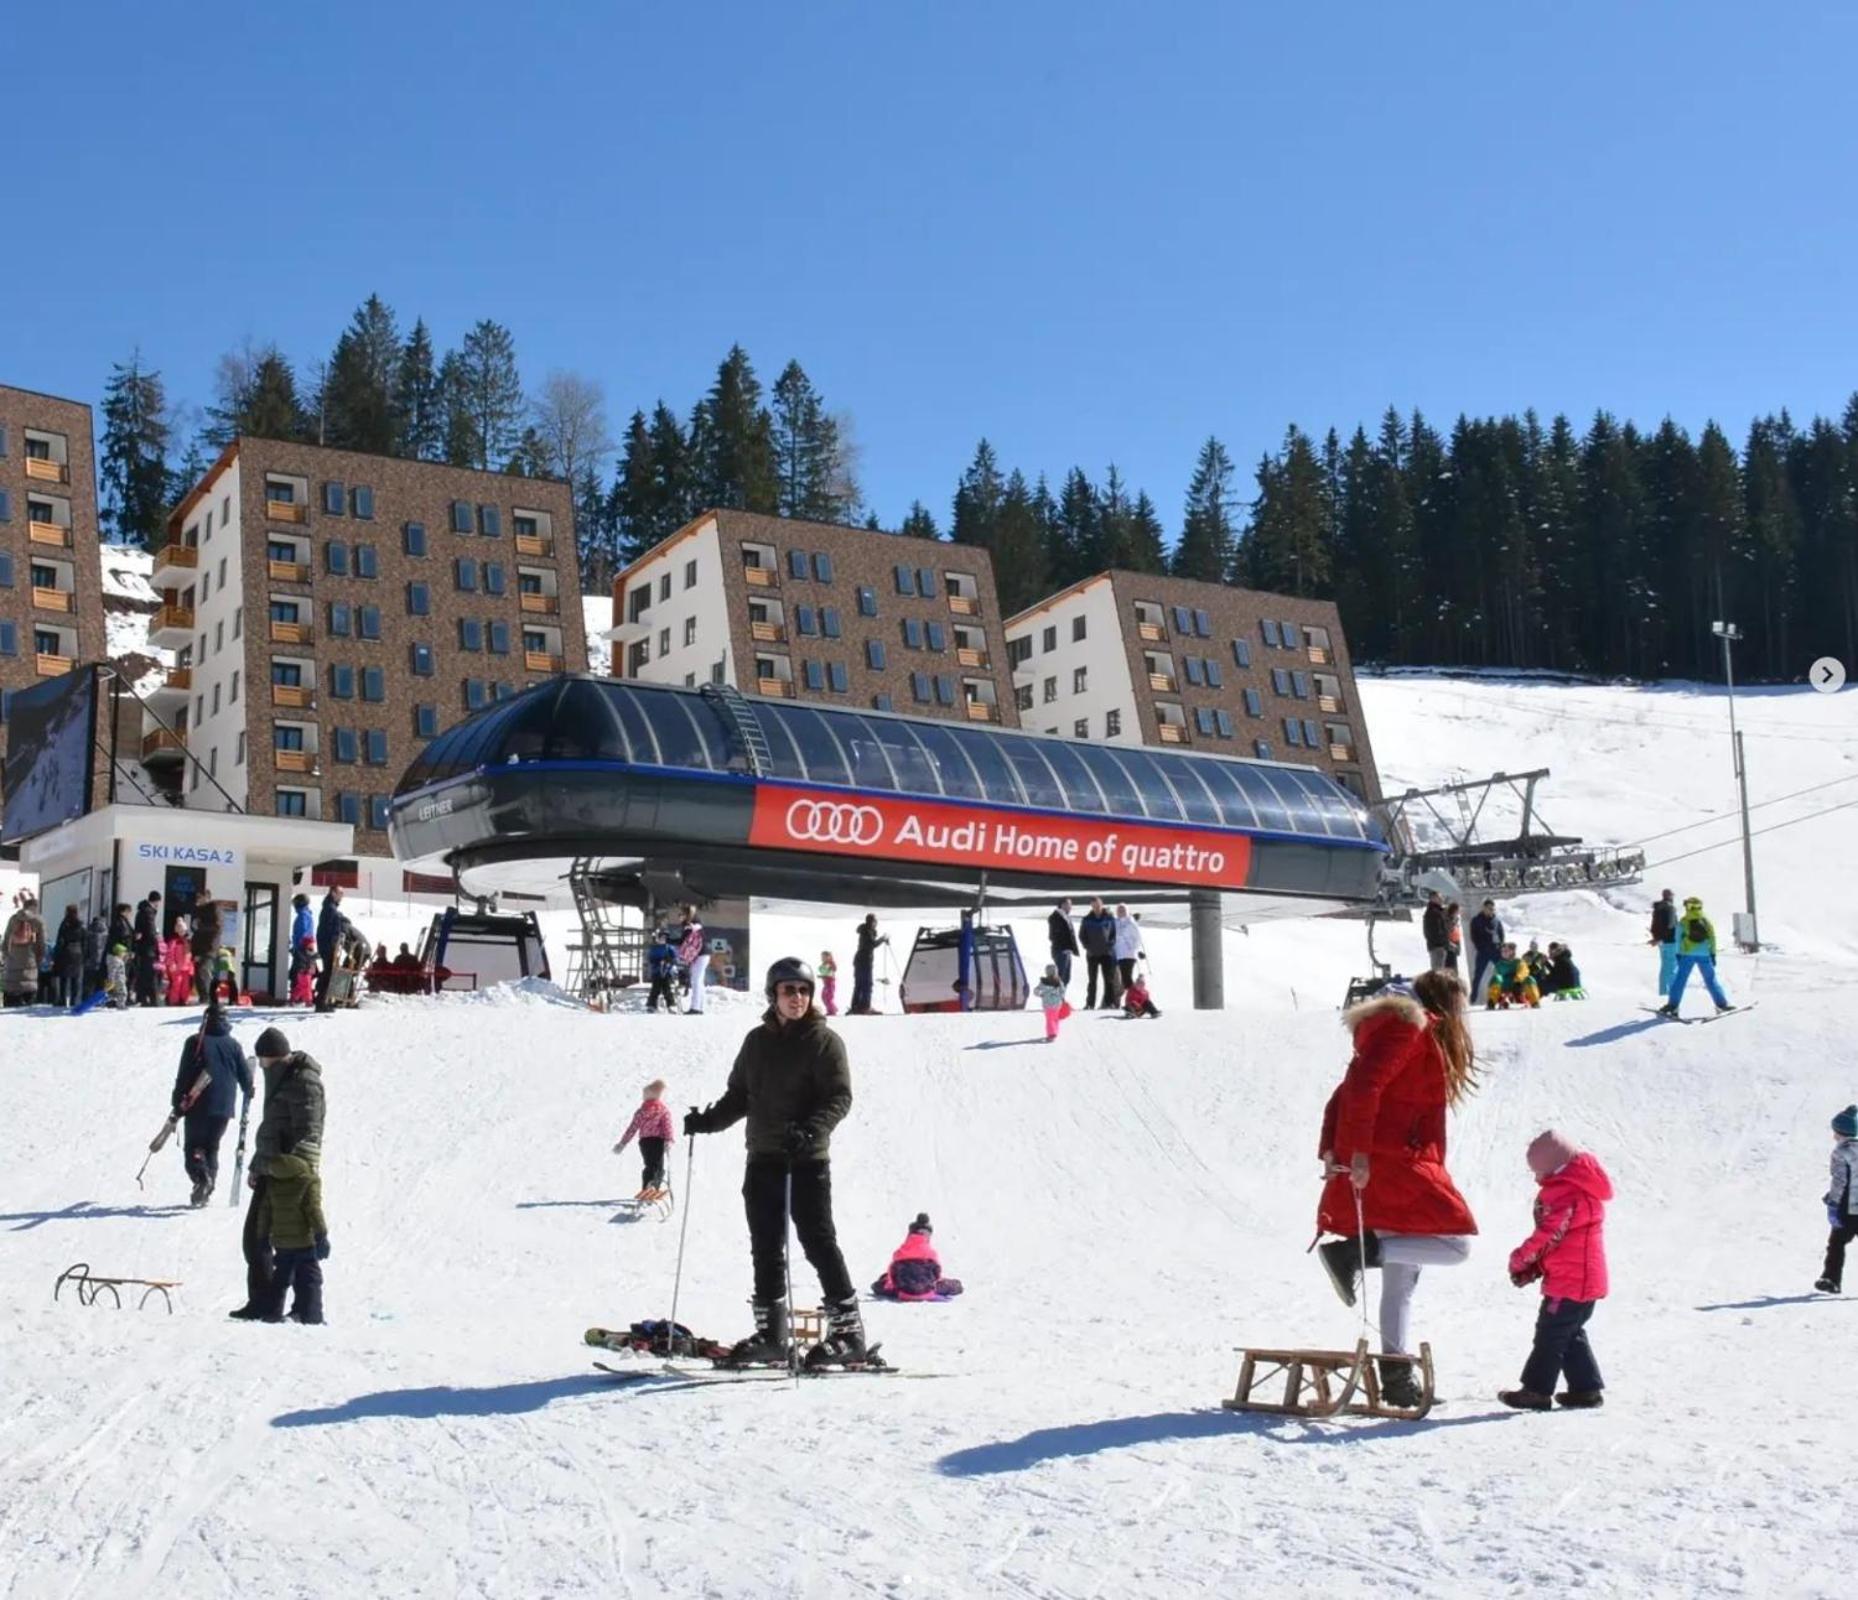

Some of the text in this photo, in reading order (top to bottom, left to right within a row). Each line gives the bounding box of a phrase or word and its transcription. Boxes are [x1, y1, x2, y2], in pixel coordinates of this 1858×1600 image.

[140, 844, 234, 863] SKI KASA 2
[893, 814, 1225, 874] Audi Home of quattro
